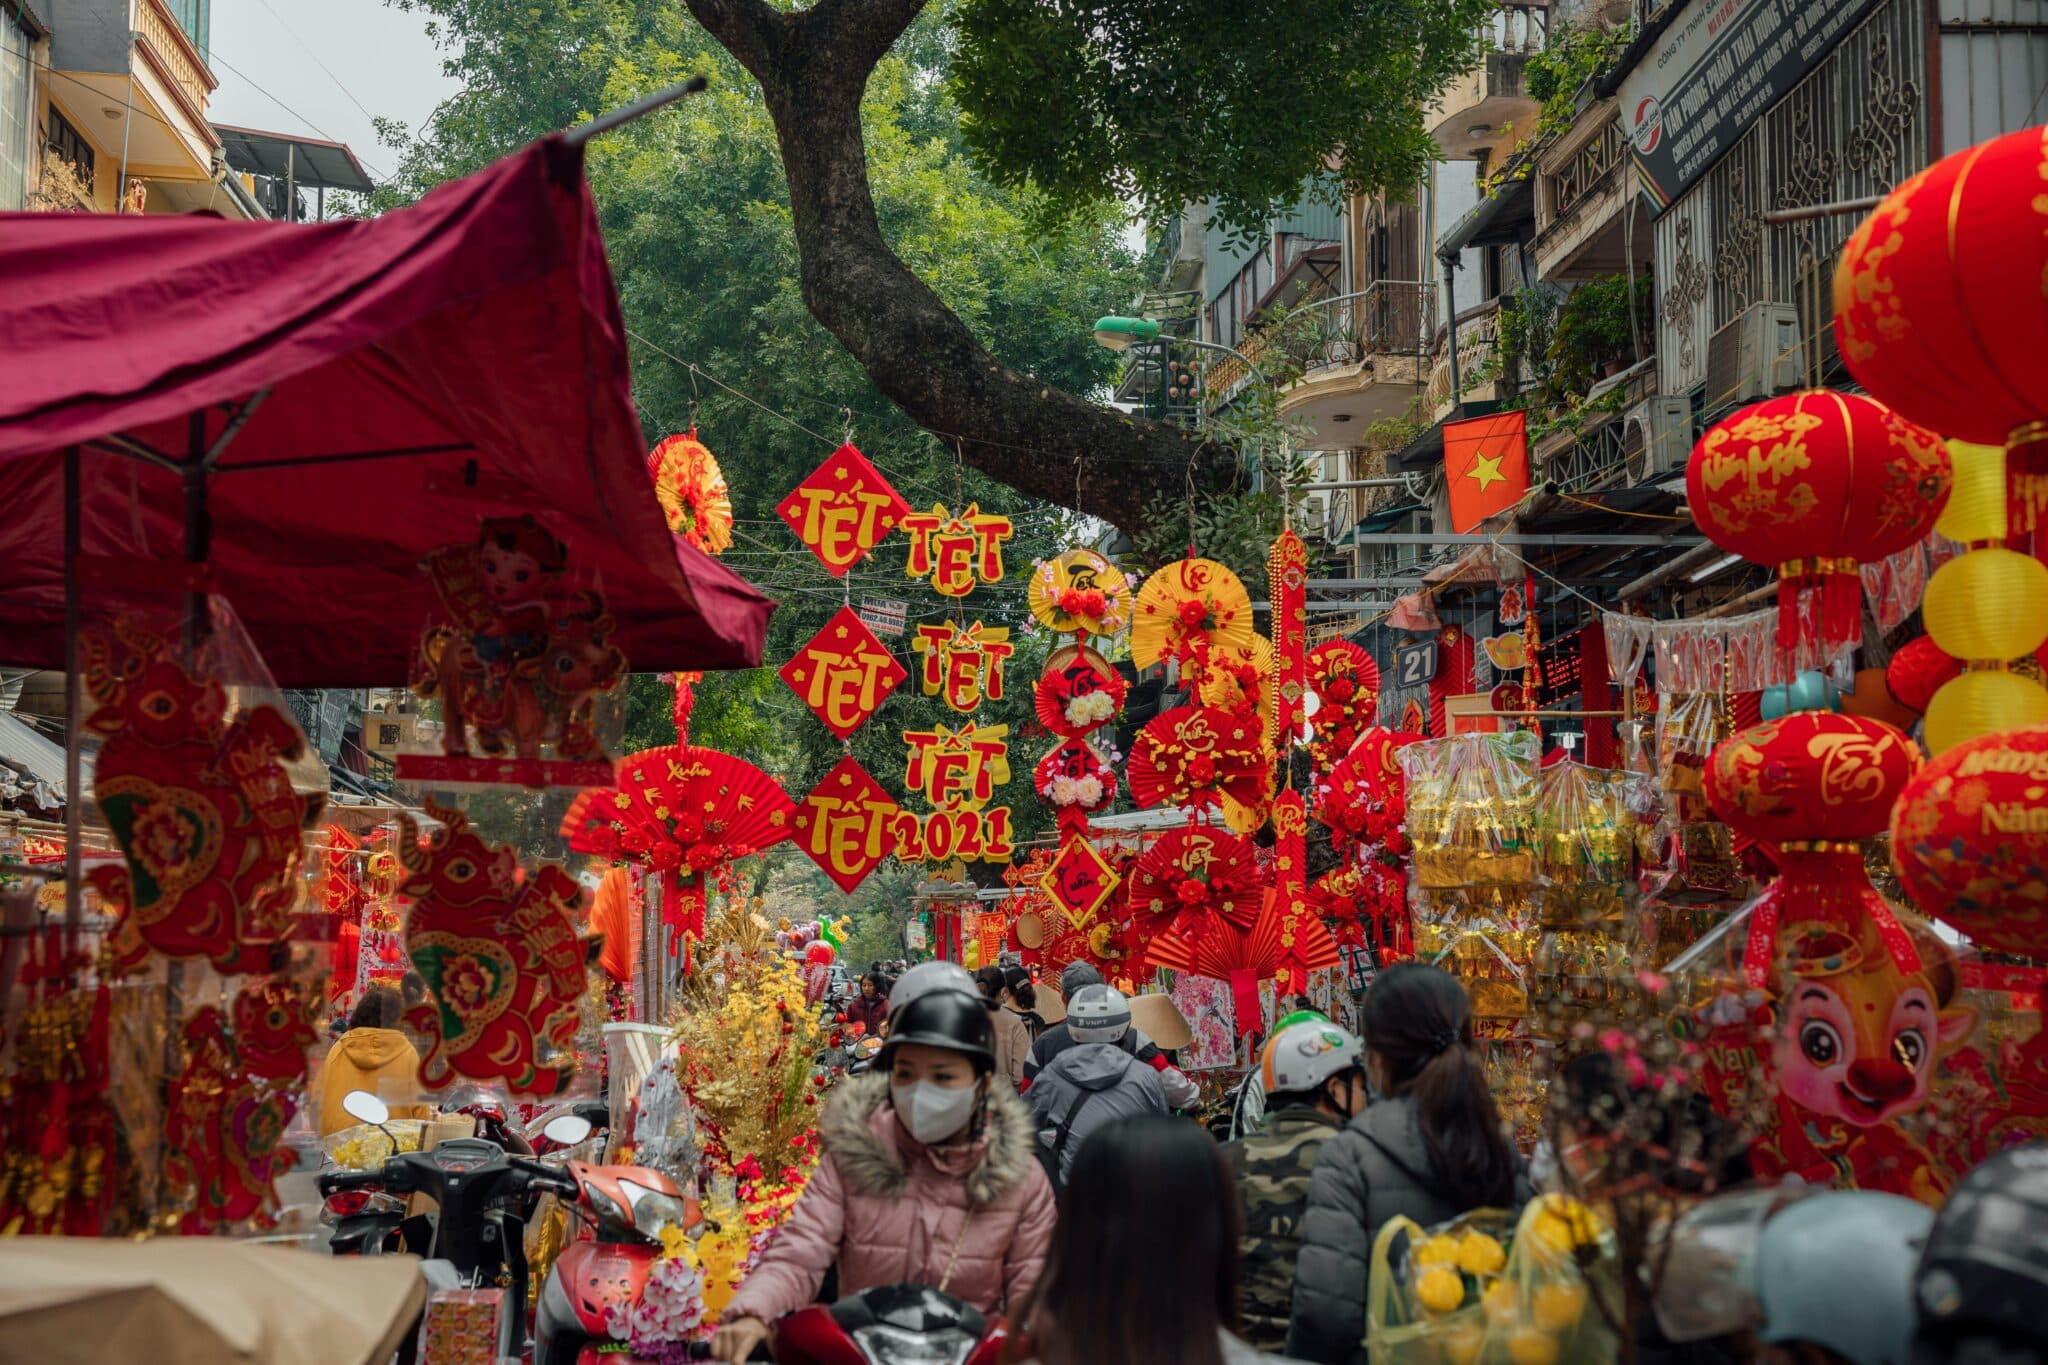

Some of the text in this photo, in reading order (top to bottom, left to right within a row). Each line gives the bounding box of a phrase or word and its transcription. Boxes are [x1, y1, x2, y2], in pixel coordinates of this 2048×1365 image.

[1676, 31, 1686, 46] TY
[1685, 9, 1706, 37] TNHH
[1680, 76, 1709, 122] PHÒNG
[1706, 48, 1735, 96] PHẨM
[1731, 23, 1756, 67] THÁI
[1752, 0, 1781, 47] HƯNG
[799, 479, 892, 566] TẾT
[900, 502, 1013, 597] TẾT
[808, 639, 891, 728] TẾT
[918, 620, 1014, 712] TẾT
[1404, 646, 1432, 684] 21
[667, 759, 712, 781] Xuân
[903, 719, 1009, 813] TẾT
[808, 786, 898, 875] TẾT
[894, 807, 1013, 864] 2021
[1085, 1019, 1107, 1027] VNPT
